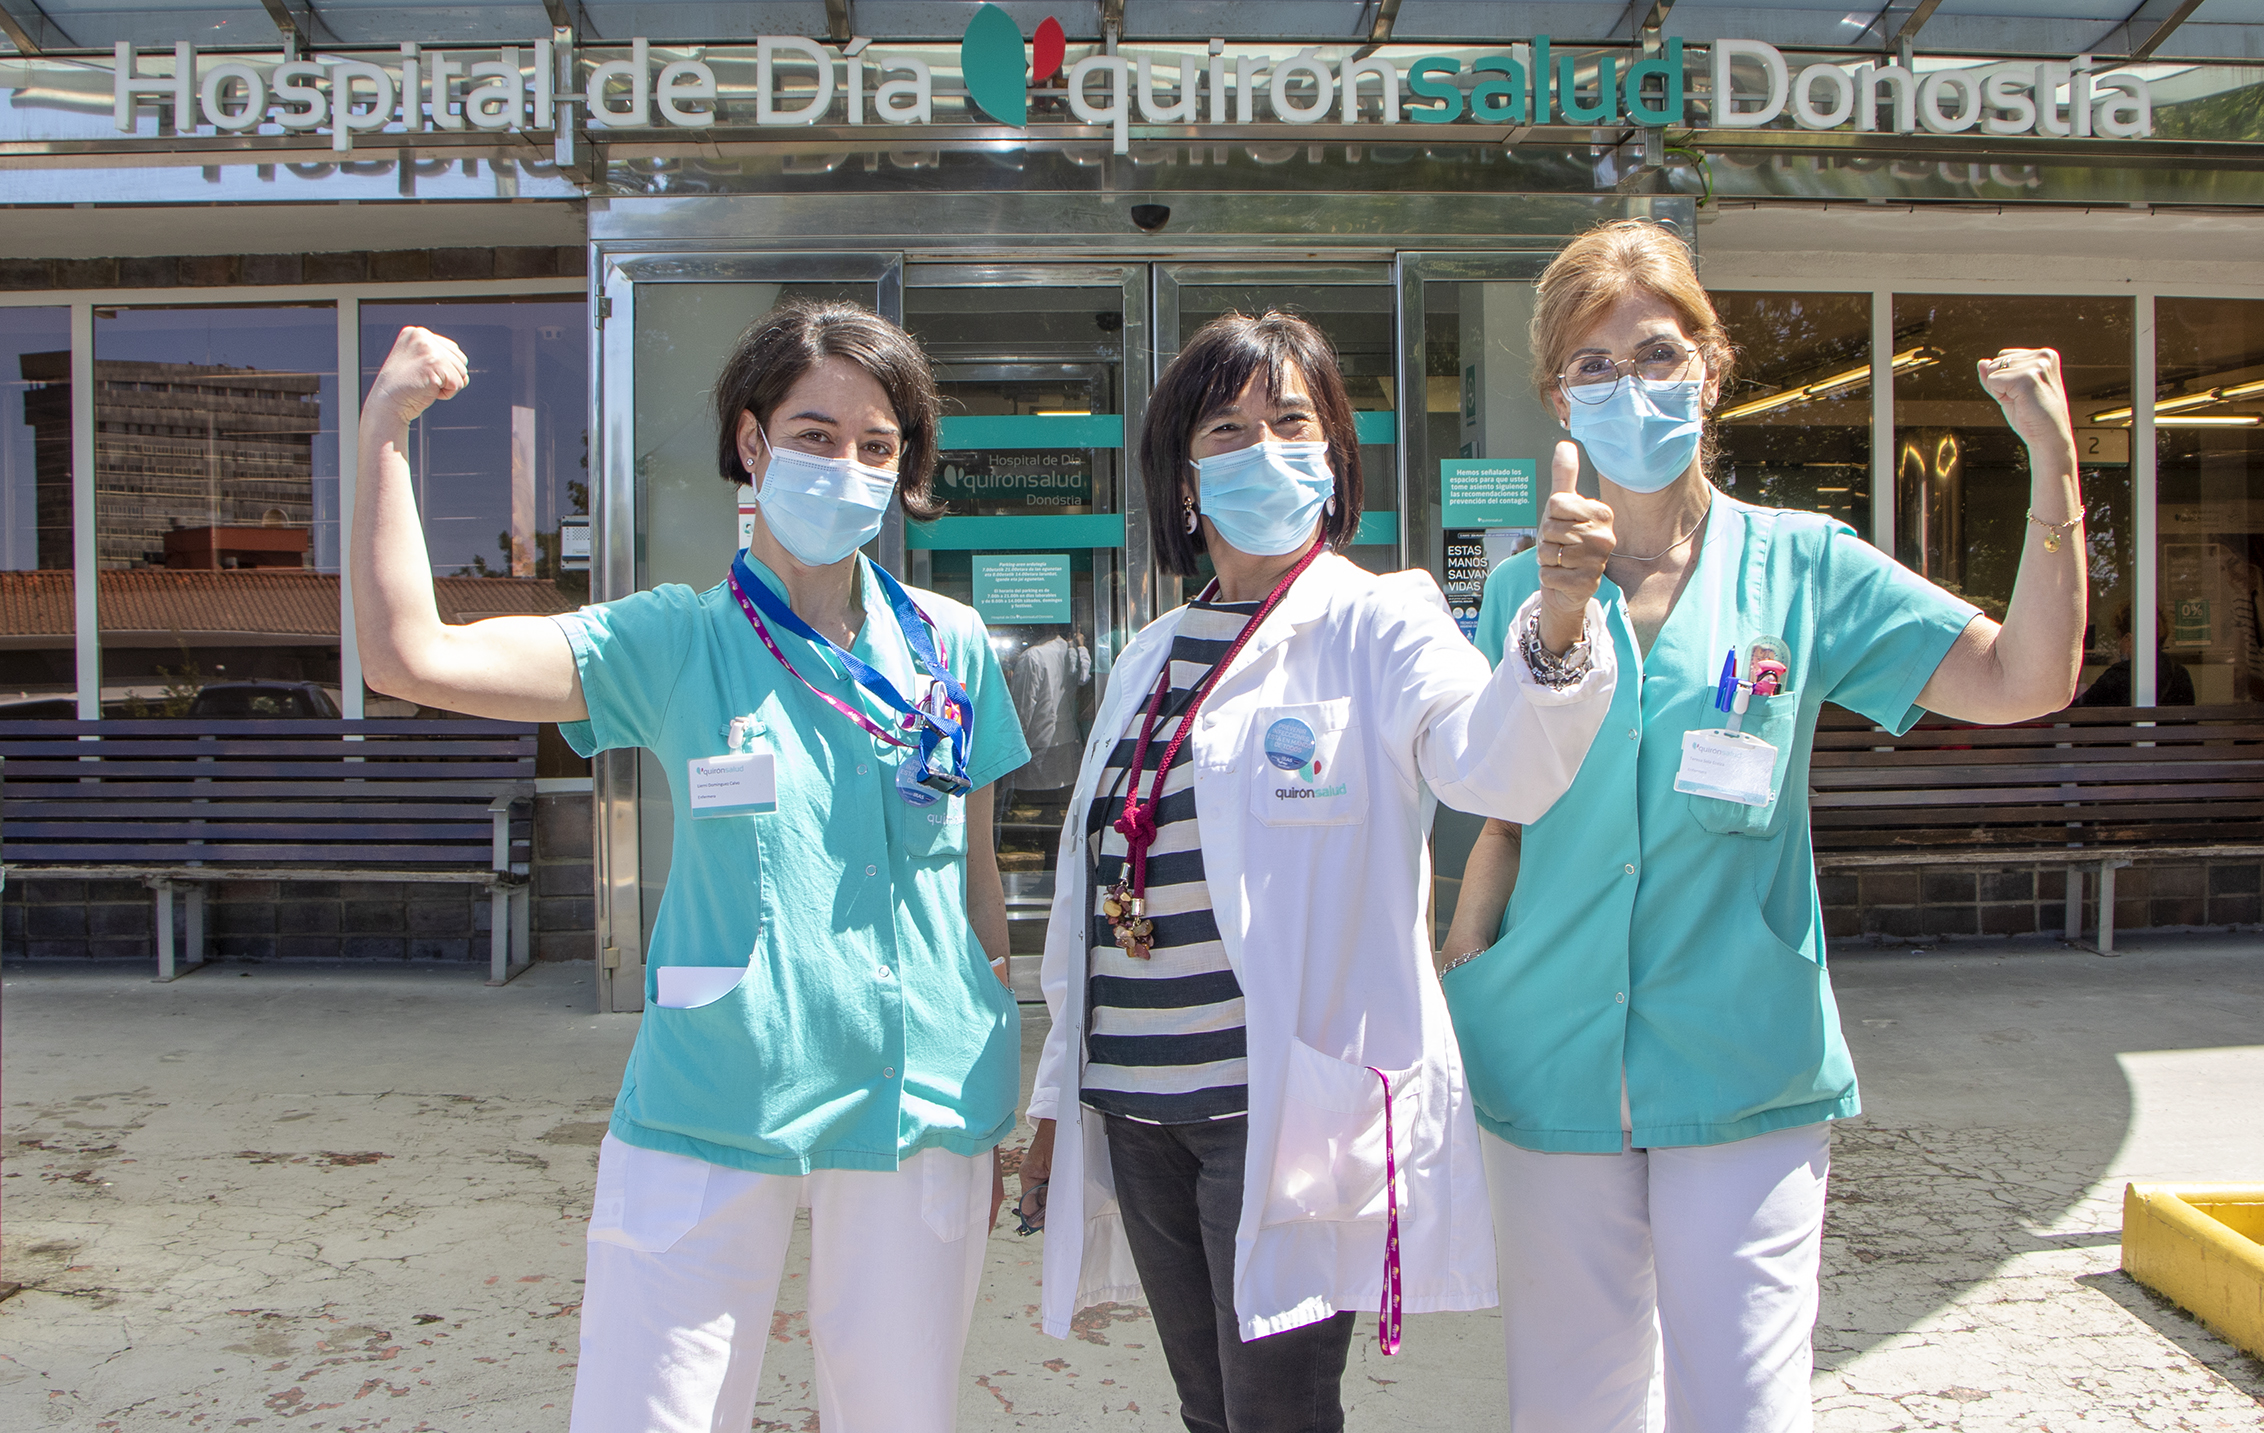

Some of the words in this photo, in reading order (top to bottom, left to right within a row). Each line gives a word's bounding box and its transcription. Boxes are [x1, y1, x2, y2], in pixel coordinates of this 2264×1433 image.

[115, 38, 553, 151] Hospital
[588, 37, 717, 128] de
[757, 36, 932, 126] Día
[1067, 34, 1685, 155] quirónsalud
[1711, 39, 2152, 140] Donostia
[2089, 437, 2099, 454] 2
[989, 454, 1040, 468] Hospital
[1042, 454, 1058, 466] de
[1061, 453, 1081, 466] Día
[1481, 468, 1511, 476] señalado
[963, 470, 1082, 494] quirónsalud
[1449, 476, 1478, 484] espacios
[1495, 483, 1528, 491] siguiendo
[1449, 497, 1487, 506] prevención
[1499, 497, 1530, 505] contagio.
[1448, 545, 1482, 556] ESTAS
[1448, 557, 1488, 568] MANOS
[1448, 569, 1490, 580] SALVAN
[1448, 581, 1481, 591] VIDAS
[2182, 604, 2203, 617] 0%
[1275, 782, 1348, 801] quirónsalud
